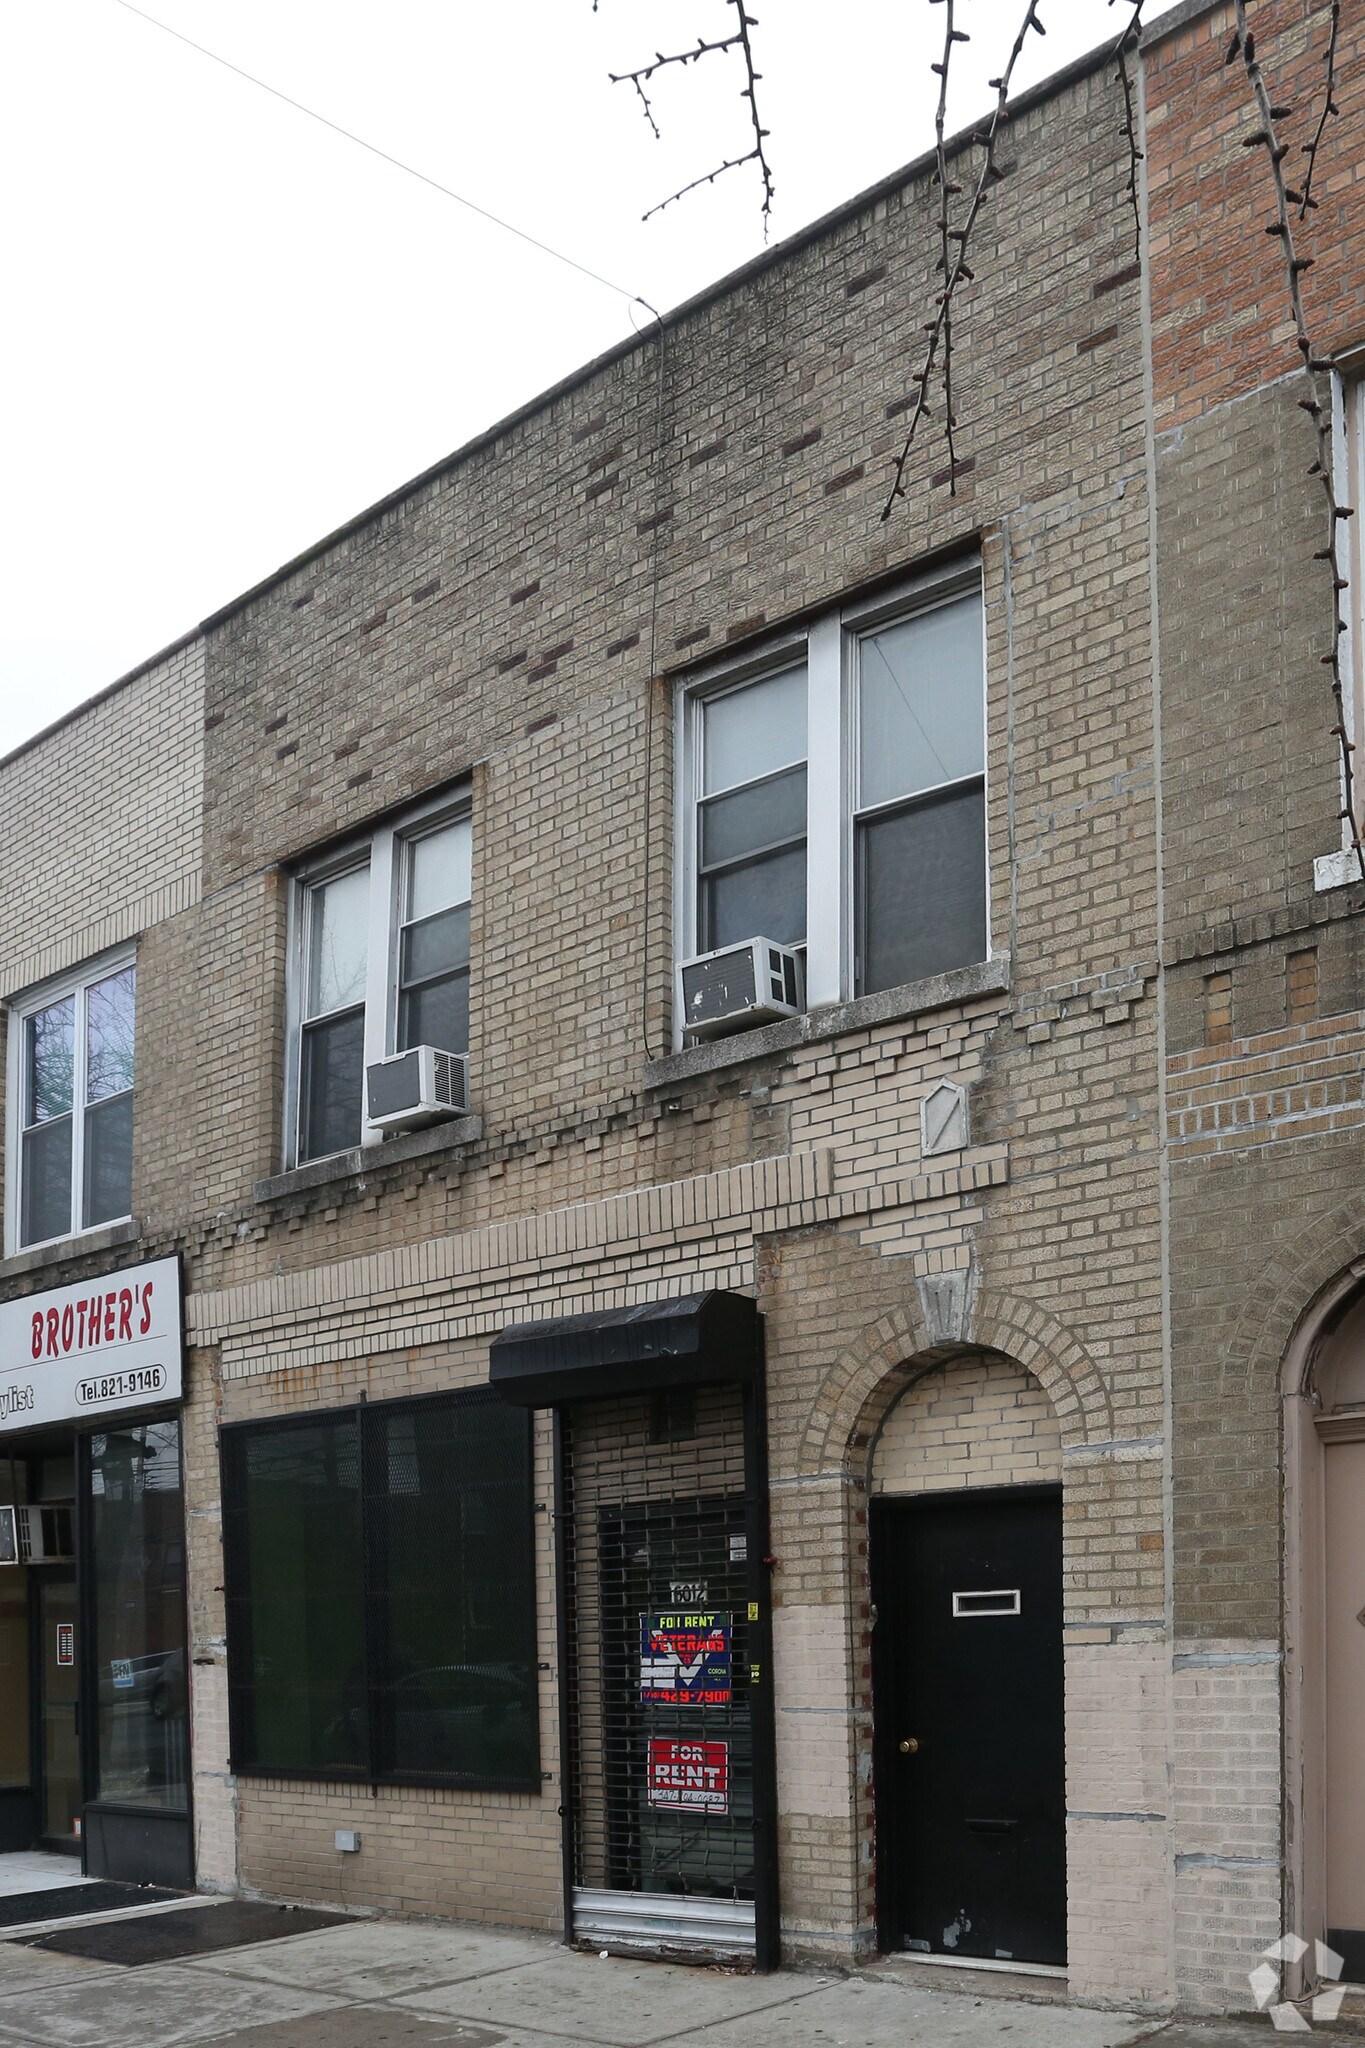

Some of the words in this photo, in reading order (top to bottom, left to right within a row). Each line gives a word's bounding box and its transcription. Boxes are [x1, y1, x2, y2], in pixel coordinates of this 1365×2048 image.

[31, 1281, 153, 1358] BROTHER'S
[684, 1616, 715, 1627] RENT
[651, 1634, 725, 1651] VETERANS
[671, 1745, 703, 1761] FOR
[655, 1765, 720, 1788] RENT
